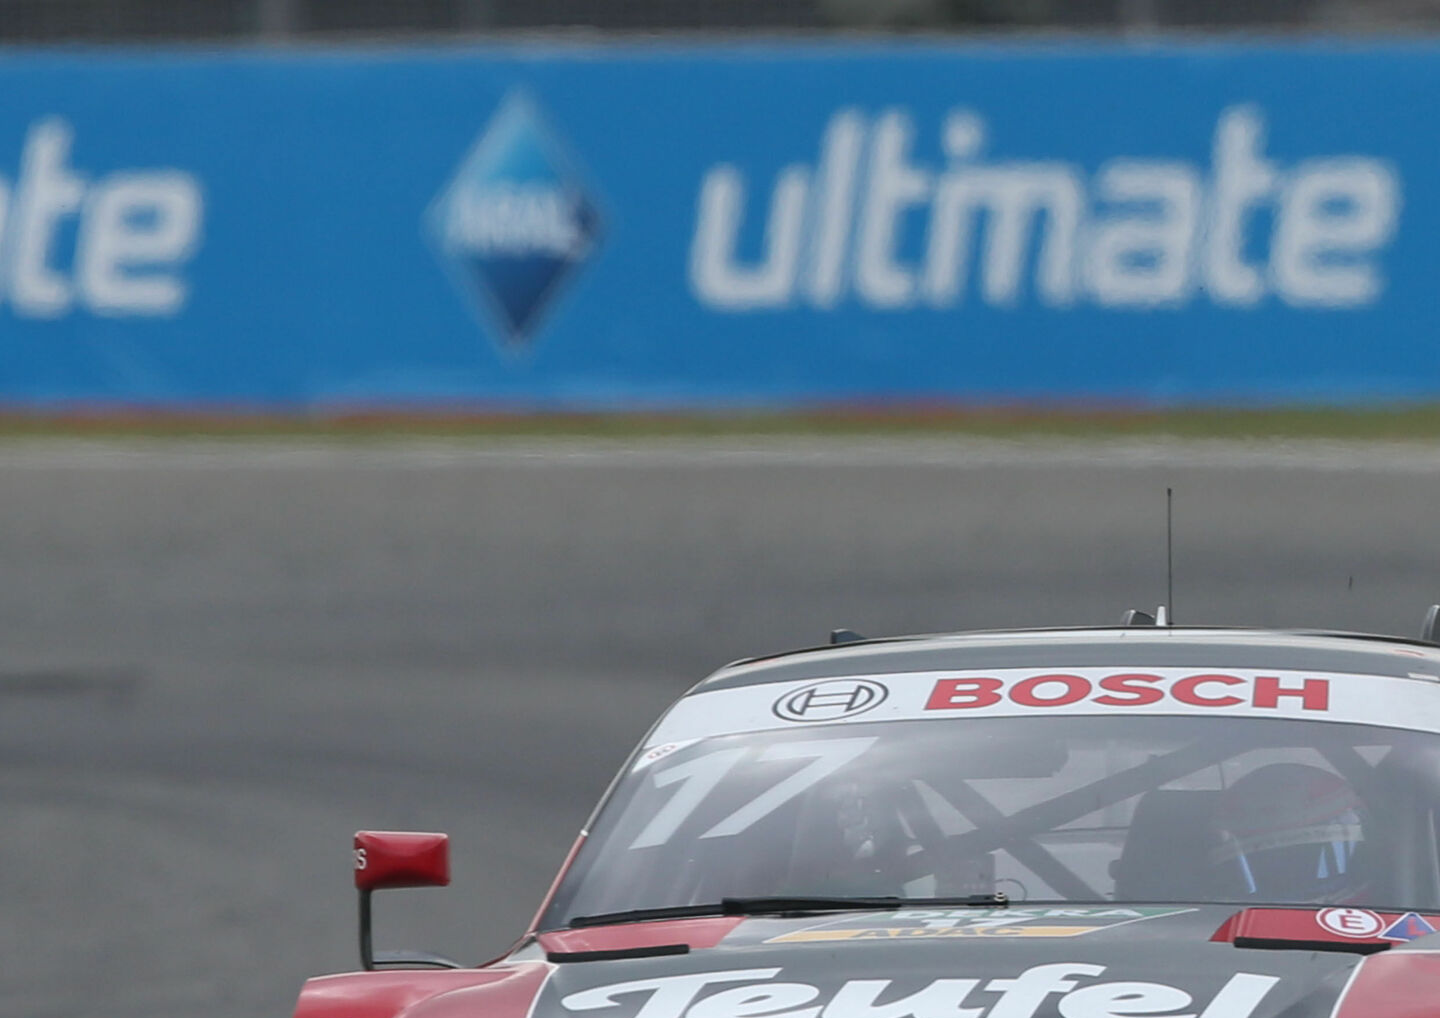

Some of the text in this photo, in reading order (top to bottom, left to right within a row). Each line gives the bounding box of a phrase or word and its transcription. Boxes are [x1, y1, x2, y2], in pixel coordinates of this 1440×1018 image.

[0, 115, 203, 318] te
[692, 103, 1400, 308] ultimate
[923, 673, 1330, 711] BOSCH
[628, 736, 881, 850] 17
[851, 927, 1023, 938] ADAC
[891, 908, 1144, 919] DEKRA
